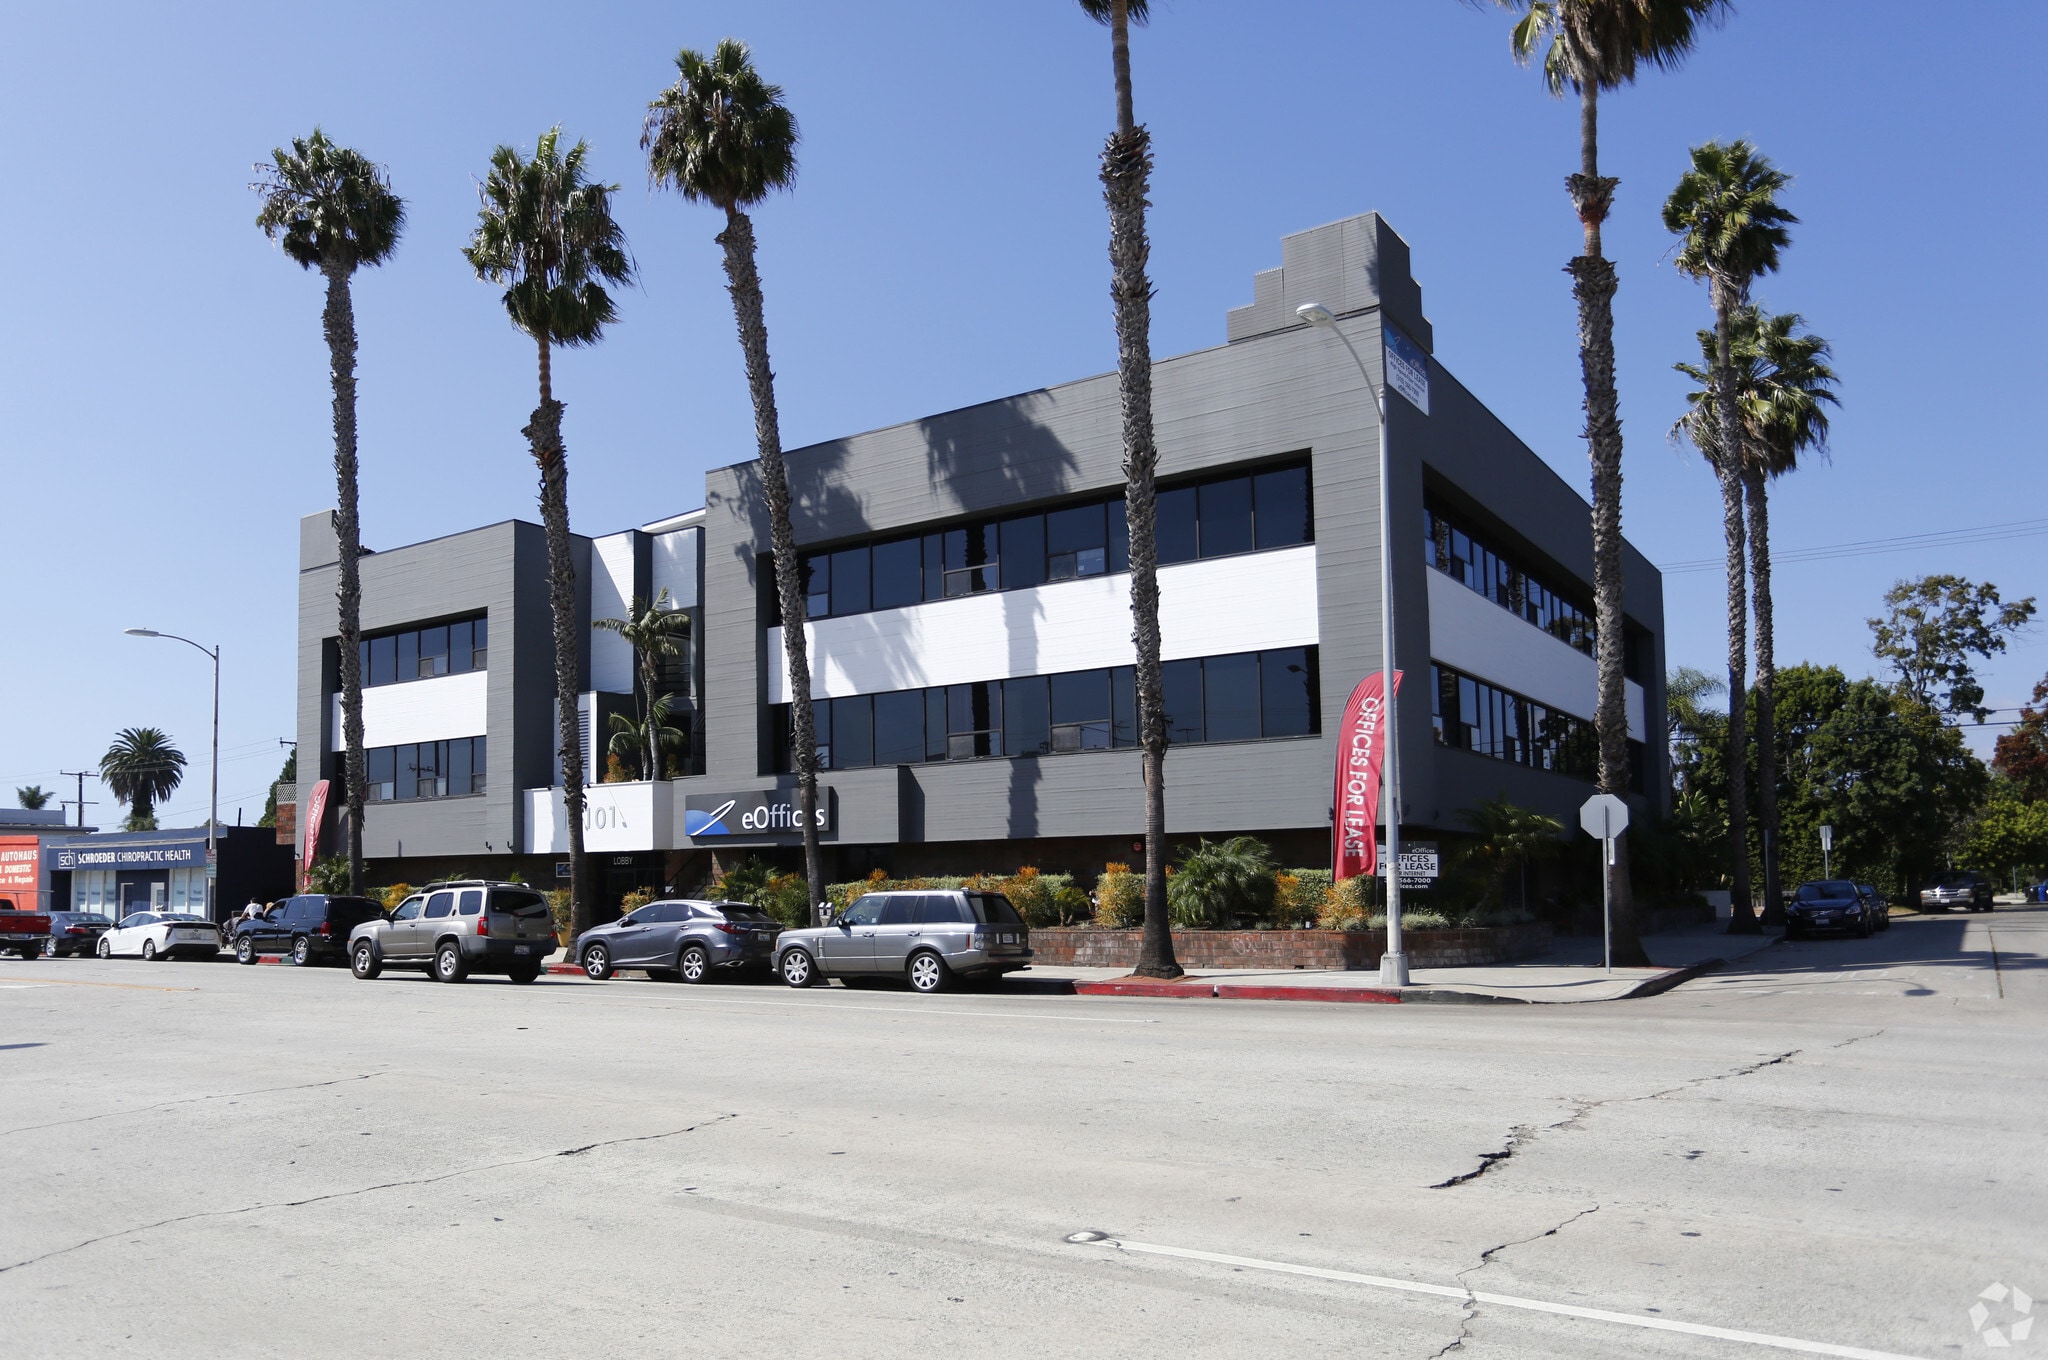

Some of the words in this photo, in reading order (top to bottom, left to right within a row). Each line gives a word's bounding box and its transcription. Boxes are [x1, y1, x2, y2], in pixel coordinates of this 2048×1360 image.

[1350, 697, 1379, 767] OFFICES
[1346, 770, 1367, 806] FOR
[741, 803, 825, 830] eOffics
[1344, 810, 1364, 857] LEASE
[1, 850, 38, 862] AUTOHAUS
[78, 851, 116, 864] SCHROEDER
[117, 850, 164, 862] CHIROPRACTIC
[165, 849, 191, 861] HEALTH
[613, 856, 633, 866] LOBBY
[1385, 854, 1430, 863] FICES
[4, 864, 32, 874] DOMESTIC
[1405, 862, 1437, 871] LEASE
[14, 875, 34, 885] Repair
